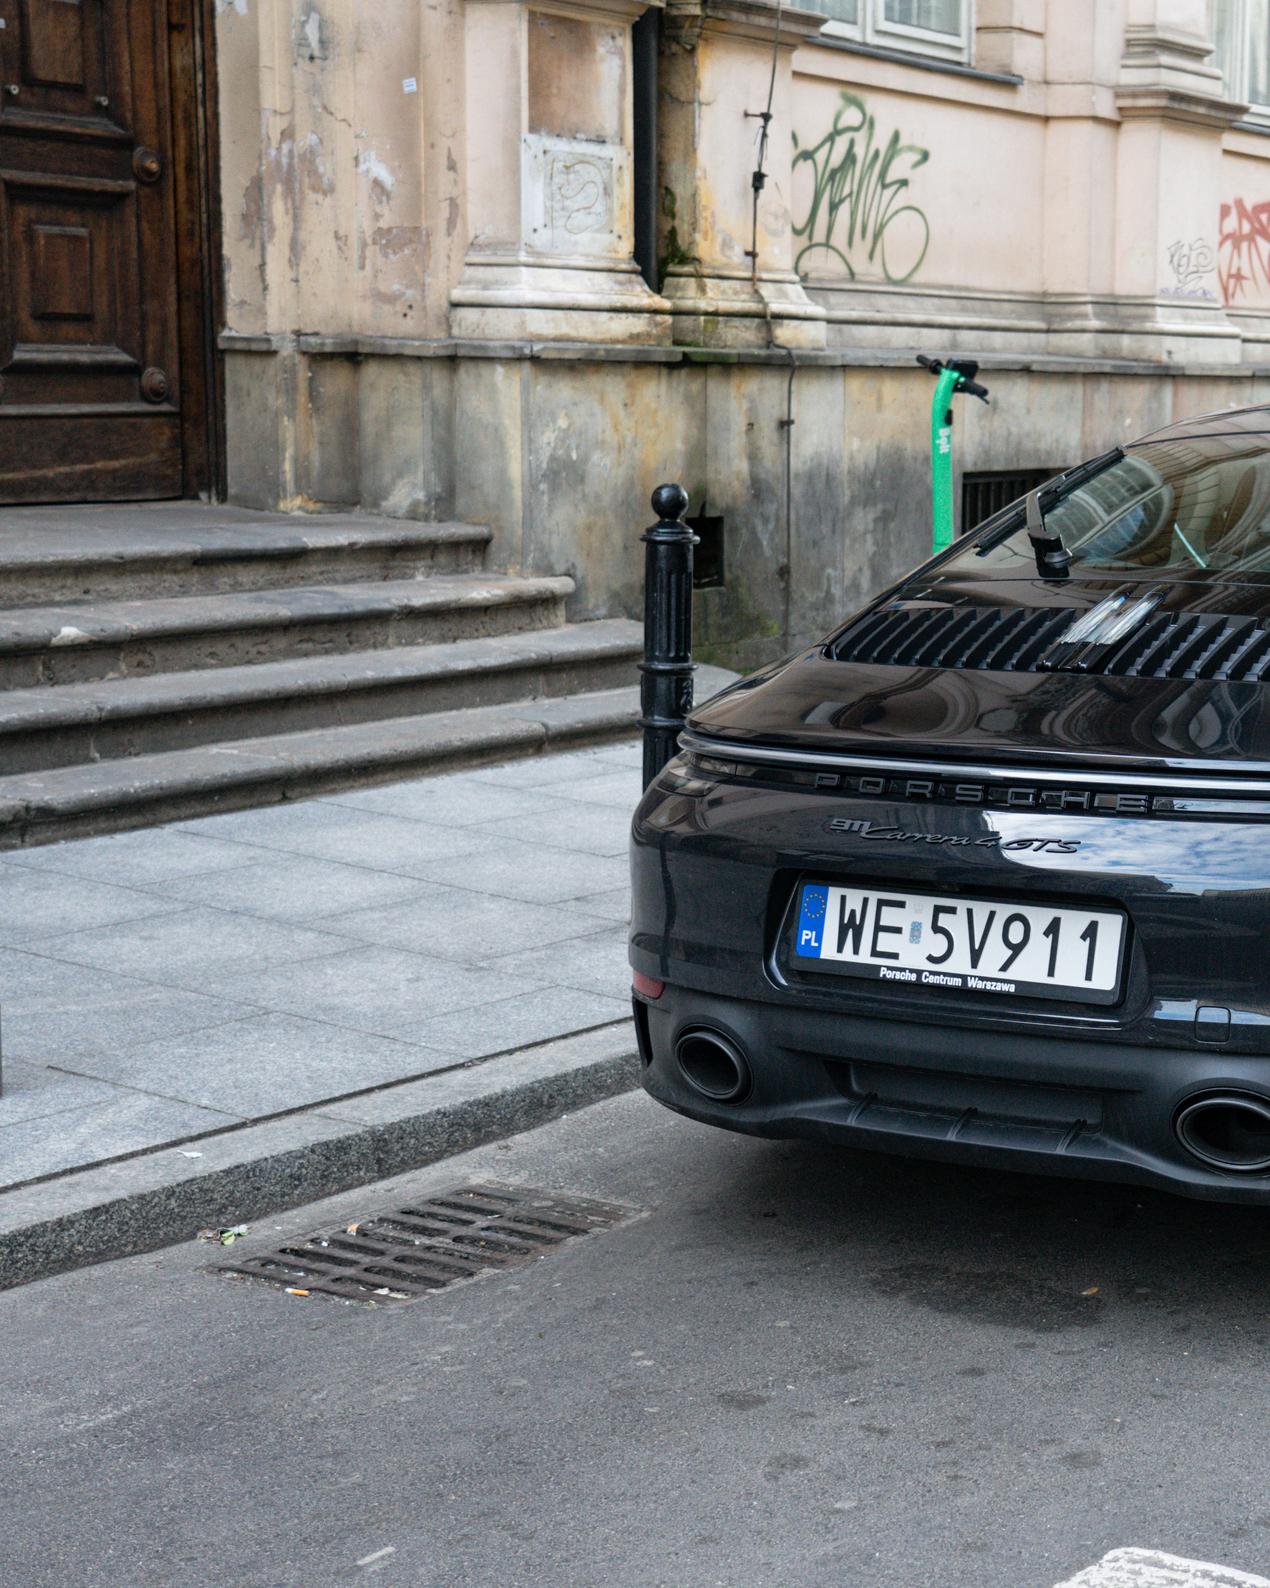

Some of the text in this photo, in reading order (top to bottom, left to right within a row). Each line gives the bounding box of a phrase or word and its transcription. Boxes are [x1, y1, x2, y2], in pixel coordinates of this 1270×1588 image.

[935, 427, 950, 454] Bolt
[813, 772, 1149, 814] PORSCHE
[829, 818, 1081, 853] 911 Carrera 4 GTS
[801, 930, 819, 947] PL
[836, 894, 1099, 981] WE 5V911
[879, 967, 1016, 993] Porsche Centrum Warszawa
